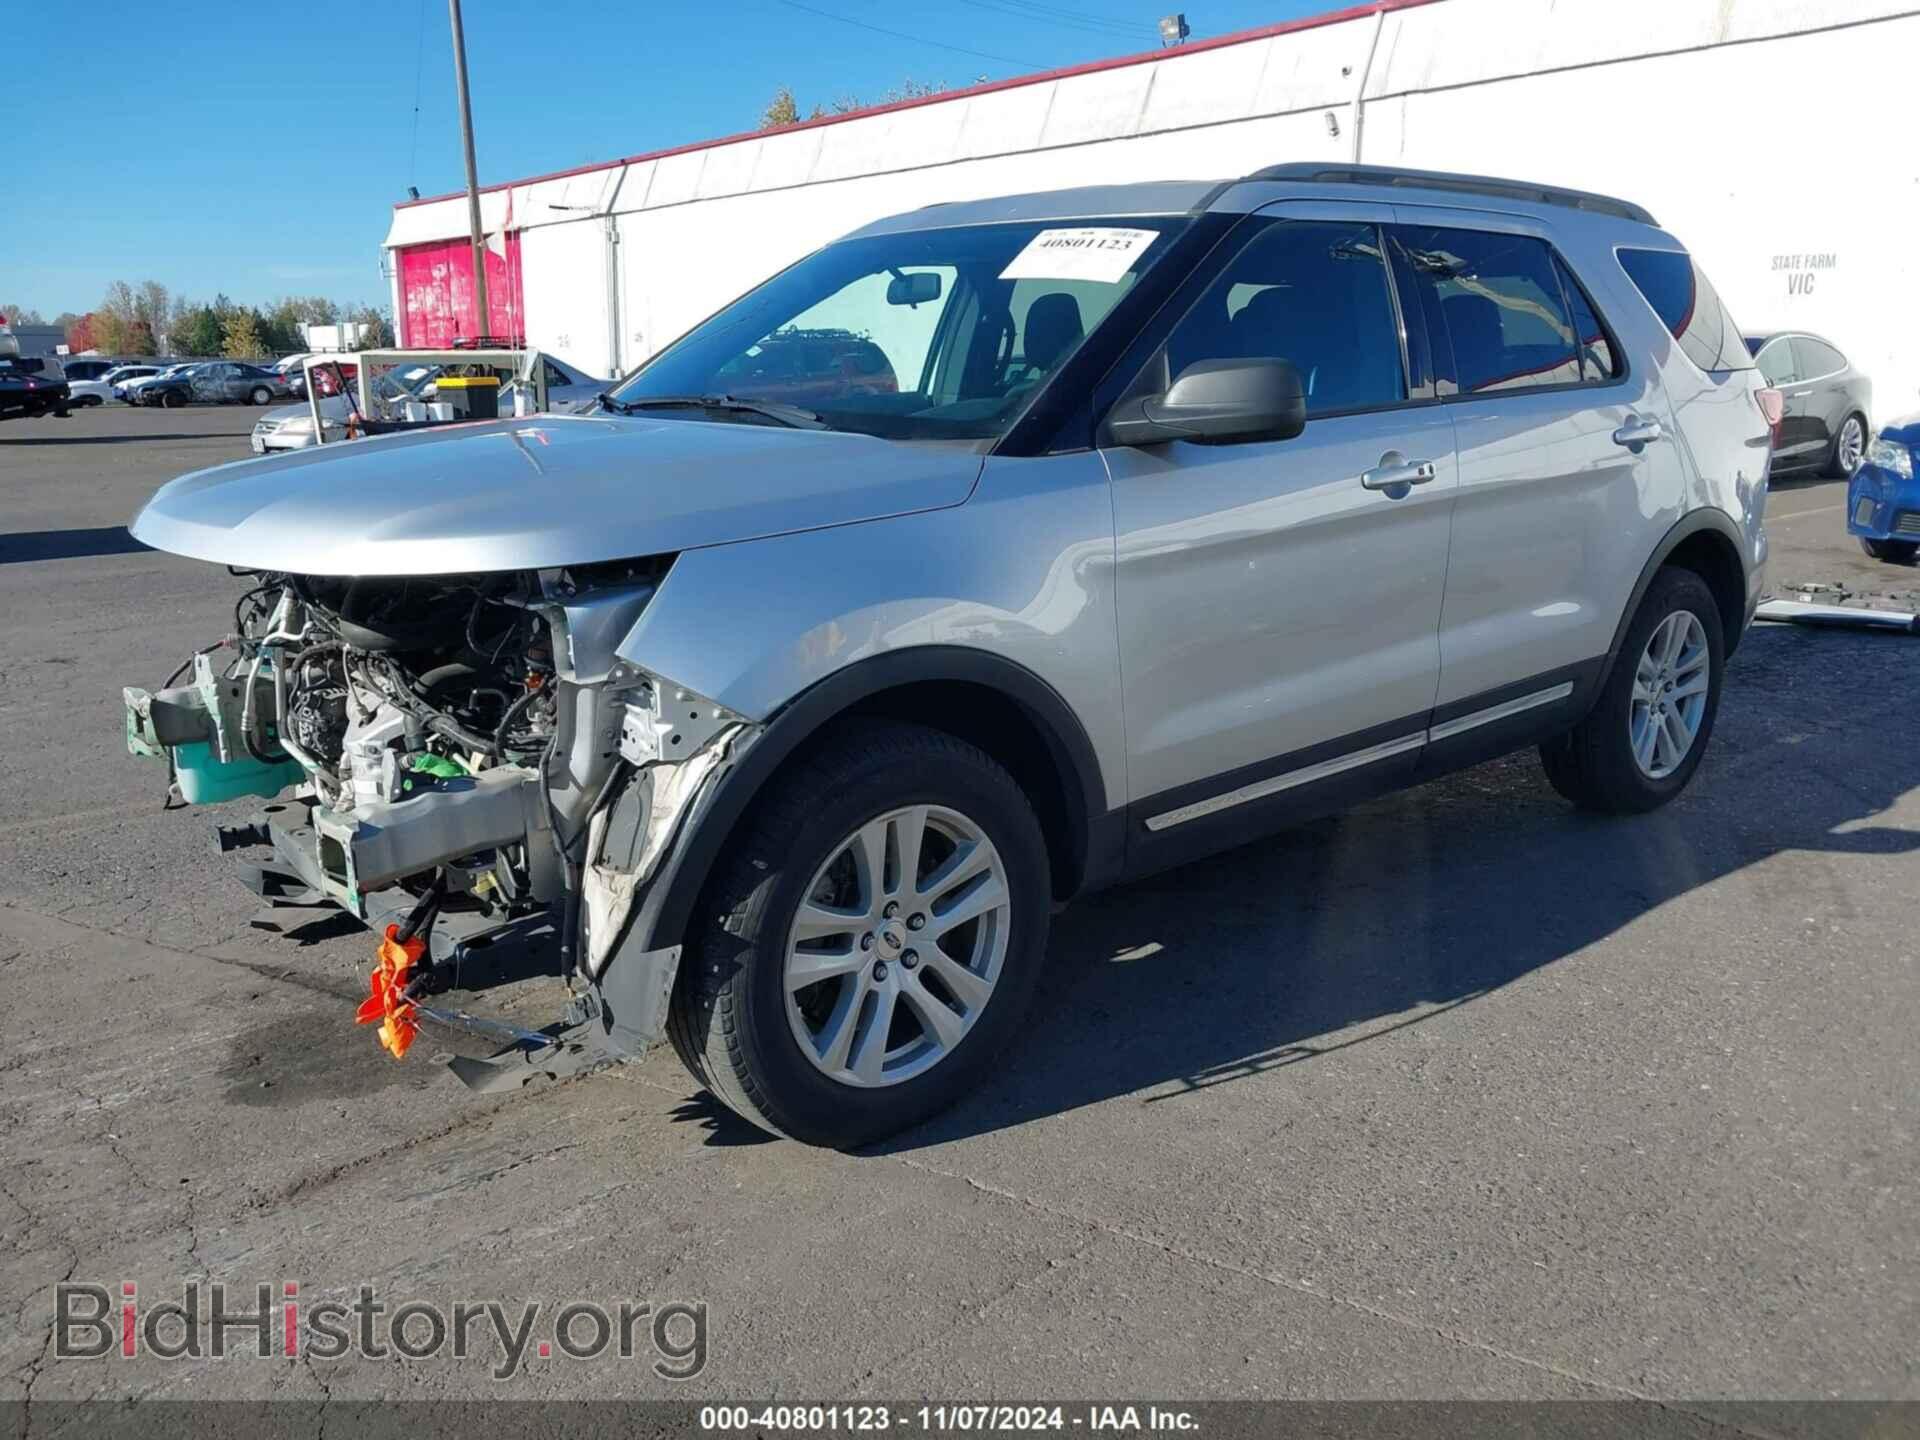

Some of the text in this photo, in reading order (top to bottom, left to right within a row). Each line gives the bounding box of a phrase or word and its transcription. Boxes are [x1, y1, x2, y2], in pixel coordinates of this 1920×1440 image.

[1040, 238, 1132, 251] 40801123
[1771, 252, 1837, 271] STATE FARM
[1788, 272, 1815, 295] VIC
